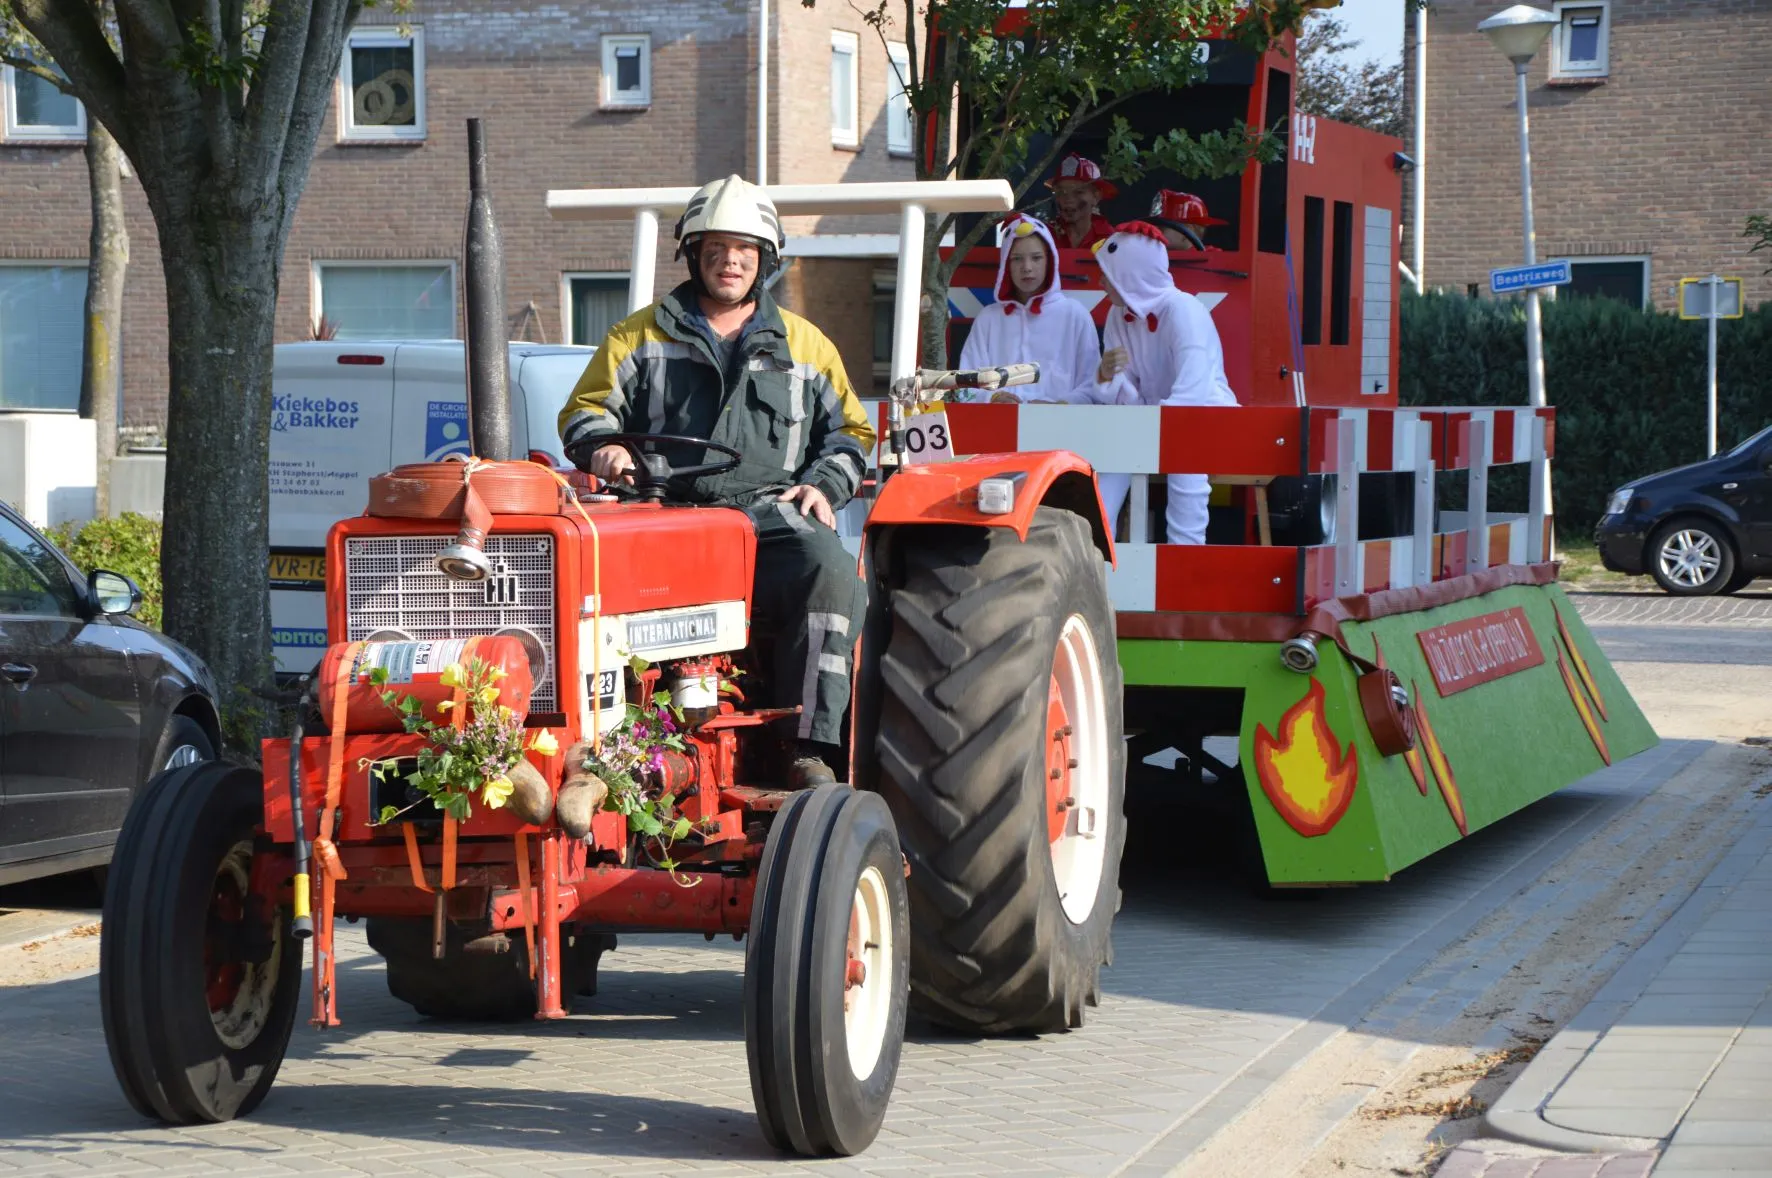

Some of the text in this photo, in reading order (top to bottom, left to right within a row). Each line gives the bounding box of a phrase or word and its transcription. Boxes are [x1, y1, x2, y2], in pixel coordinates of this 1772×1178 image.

[1496, 269, 1565, 285] Beatrixweg
[272, 393, 359, 413] Kiekebos
[271, 412, 359, 432] & Bakker
[906, 424, 948, 453] 03
[271, 488, 345, 496] iekebosbakker.nl
[269, 557, 327, 577] VR-18
[271, 631, 327, 645] NDITIO
[629, 617, 716, 645] INTERNATIONAL
